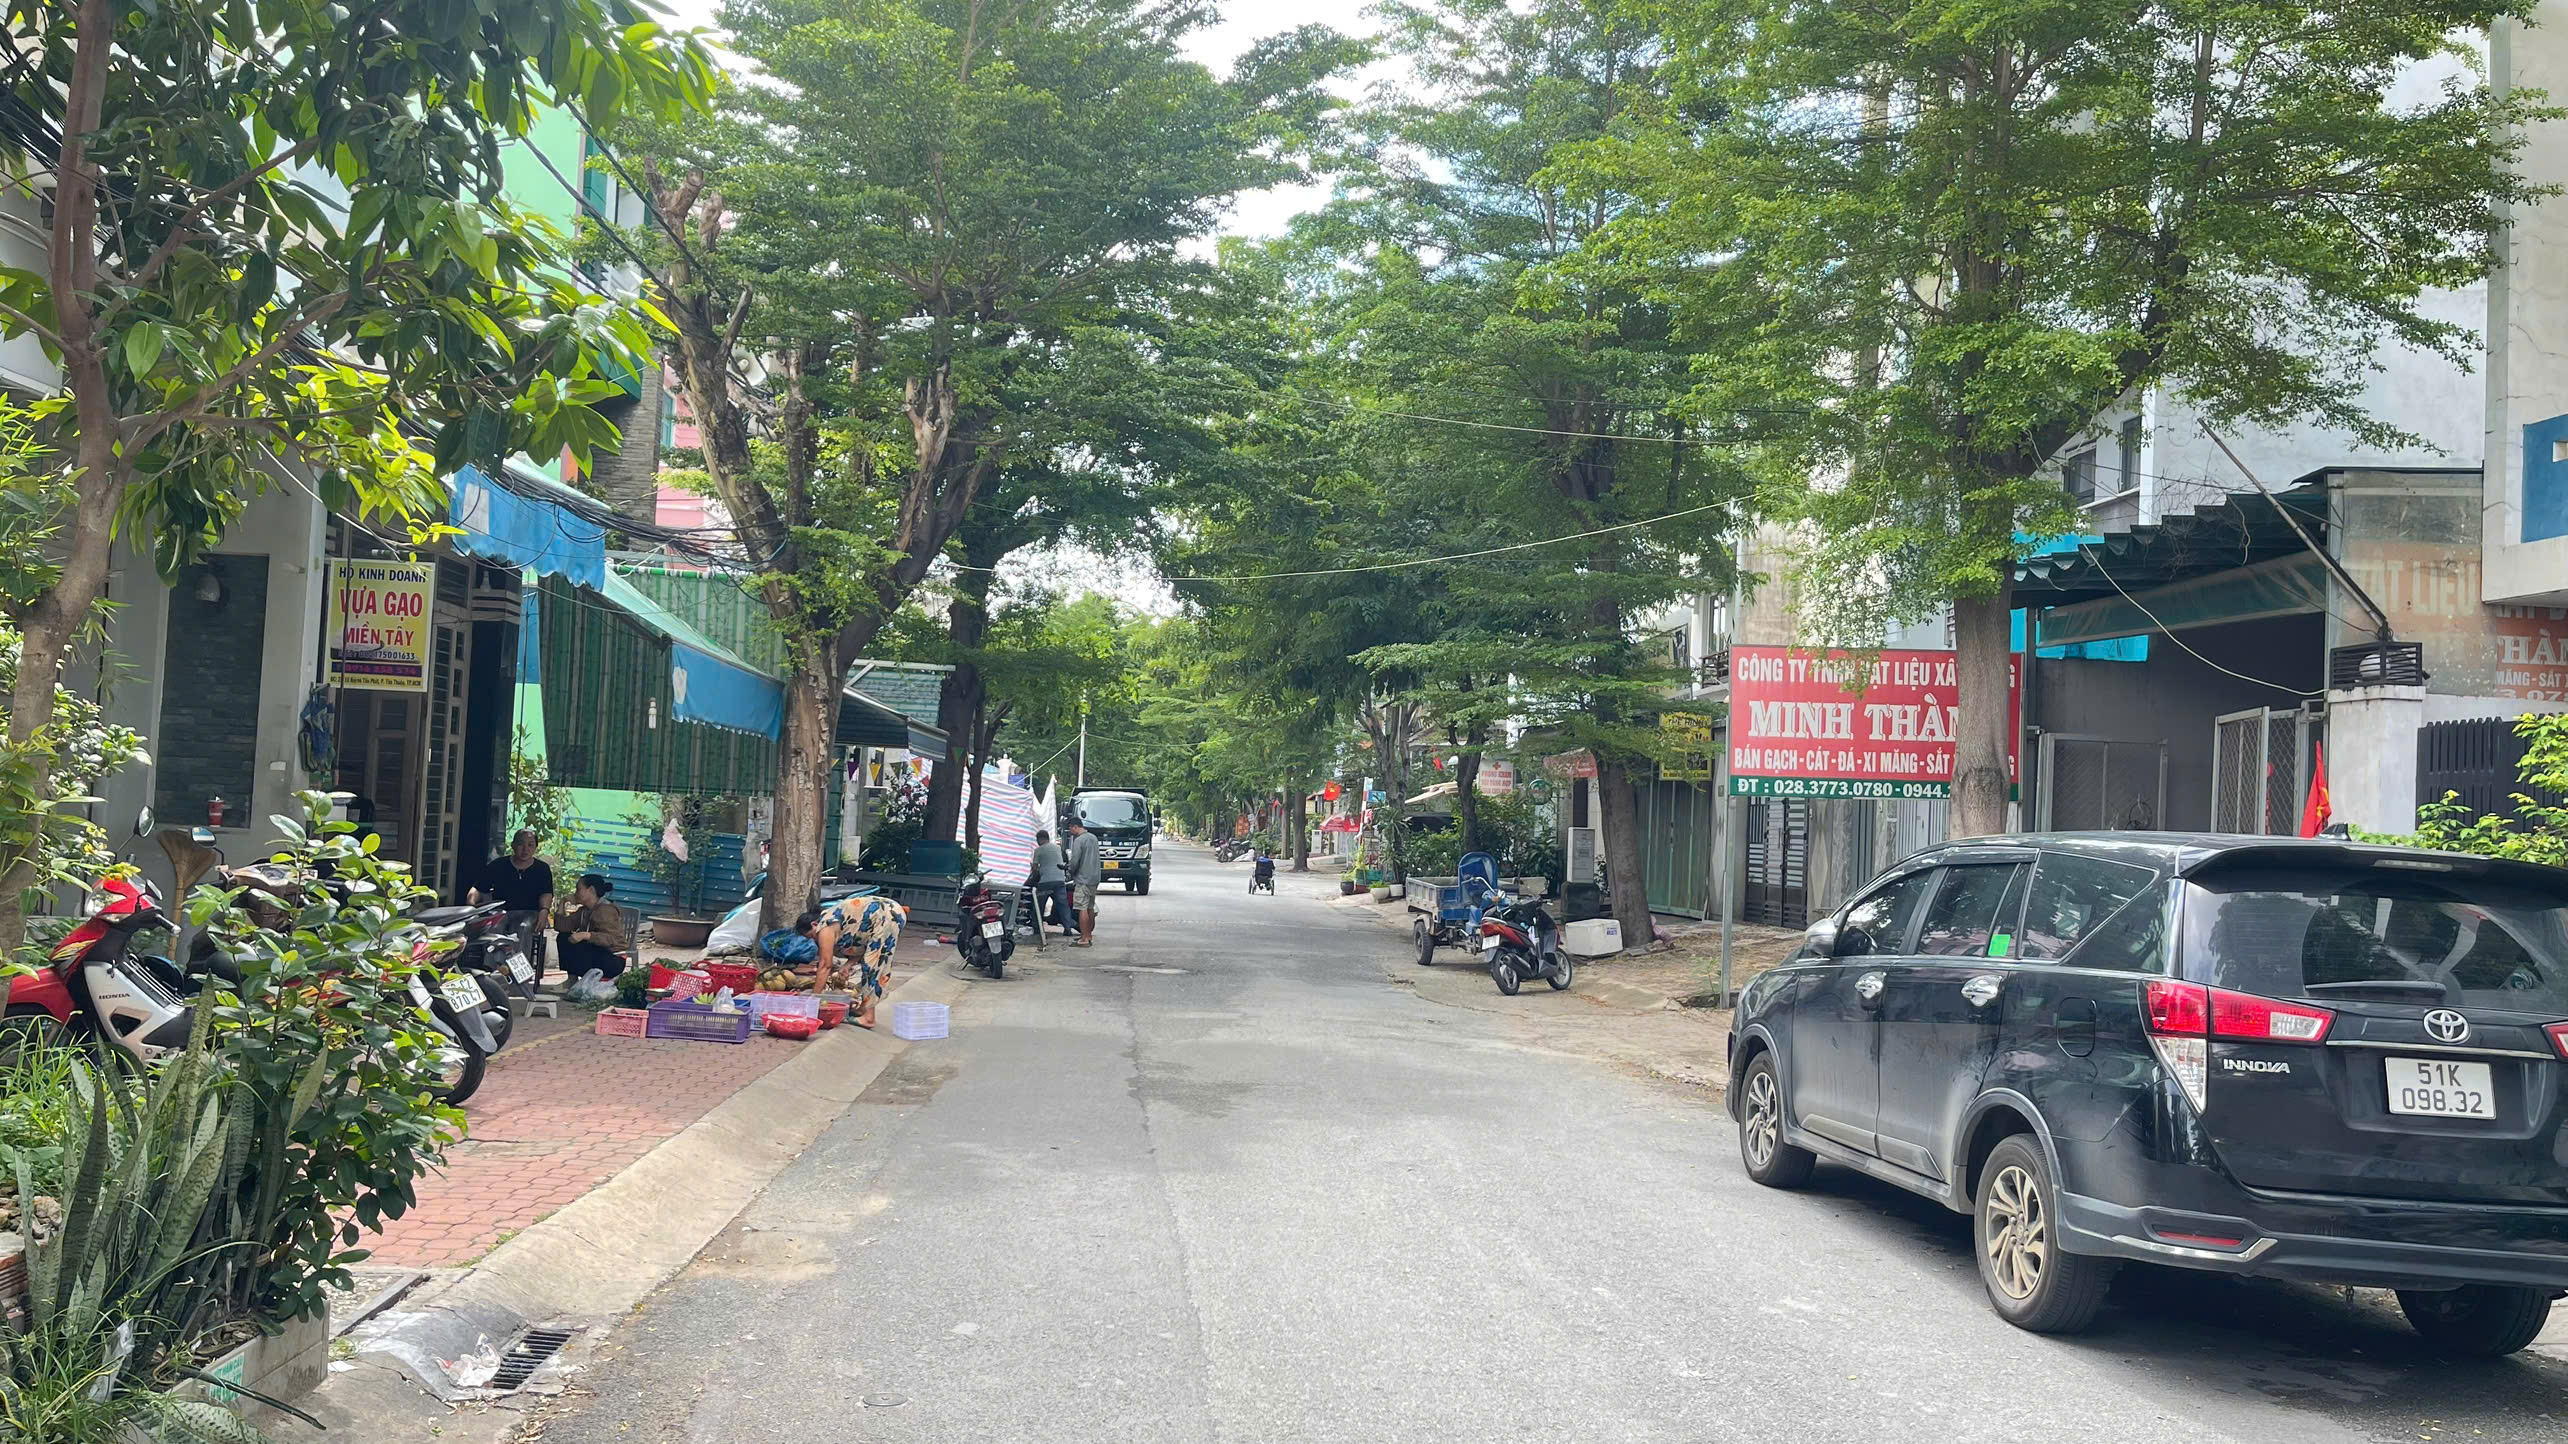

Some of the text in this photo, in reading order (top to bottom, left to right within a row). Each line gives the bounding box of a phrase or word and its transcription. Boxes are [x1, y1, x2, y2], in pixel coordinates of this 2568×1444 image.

[359, 568, 385, 580] KINH
[389, 570, 426, 583] DOANH
[384, 591, 423, 621] GẠO
[385, 626, 414, 646] TÂY
[1738, 653, 1784, 681] CÔNG
[1788, 658, 1807, 683] TY
[1894, 656, 1930, 691] LIỆU
[1934, 657, 1958, 687] XÂ
[1748, 700, 1854, 740] MINH
[1735, 744, 1760, 769] BÁN
[1738, 779, 1759, 793] ĐT
[2223, 1058, 2291, 1074] INNOVA
[2418, 1062, 2462, 1087] 51K
[2402, 1086, 2484, 1114] 098.32
